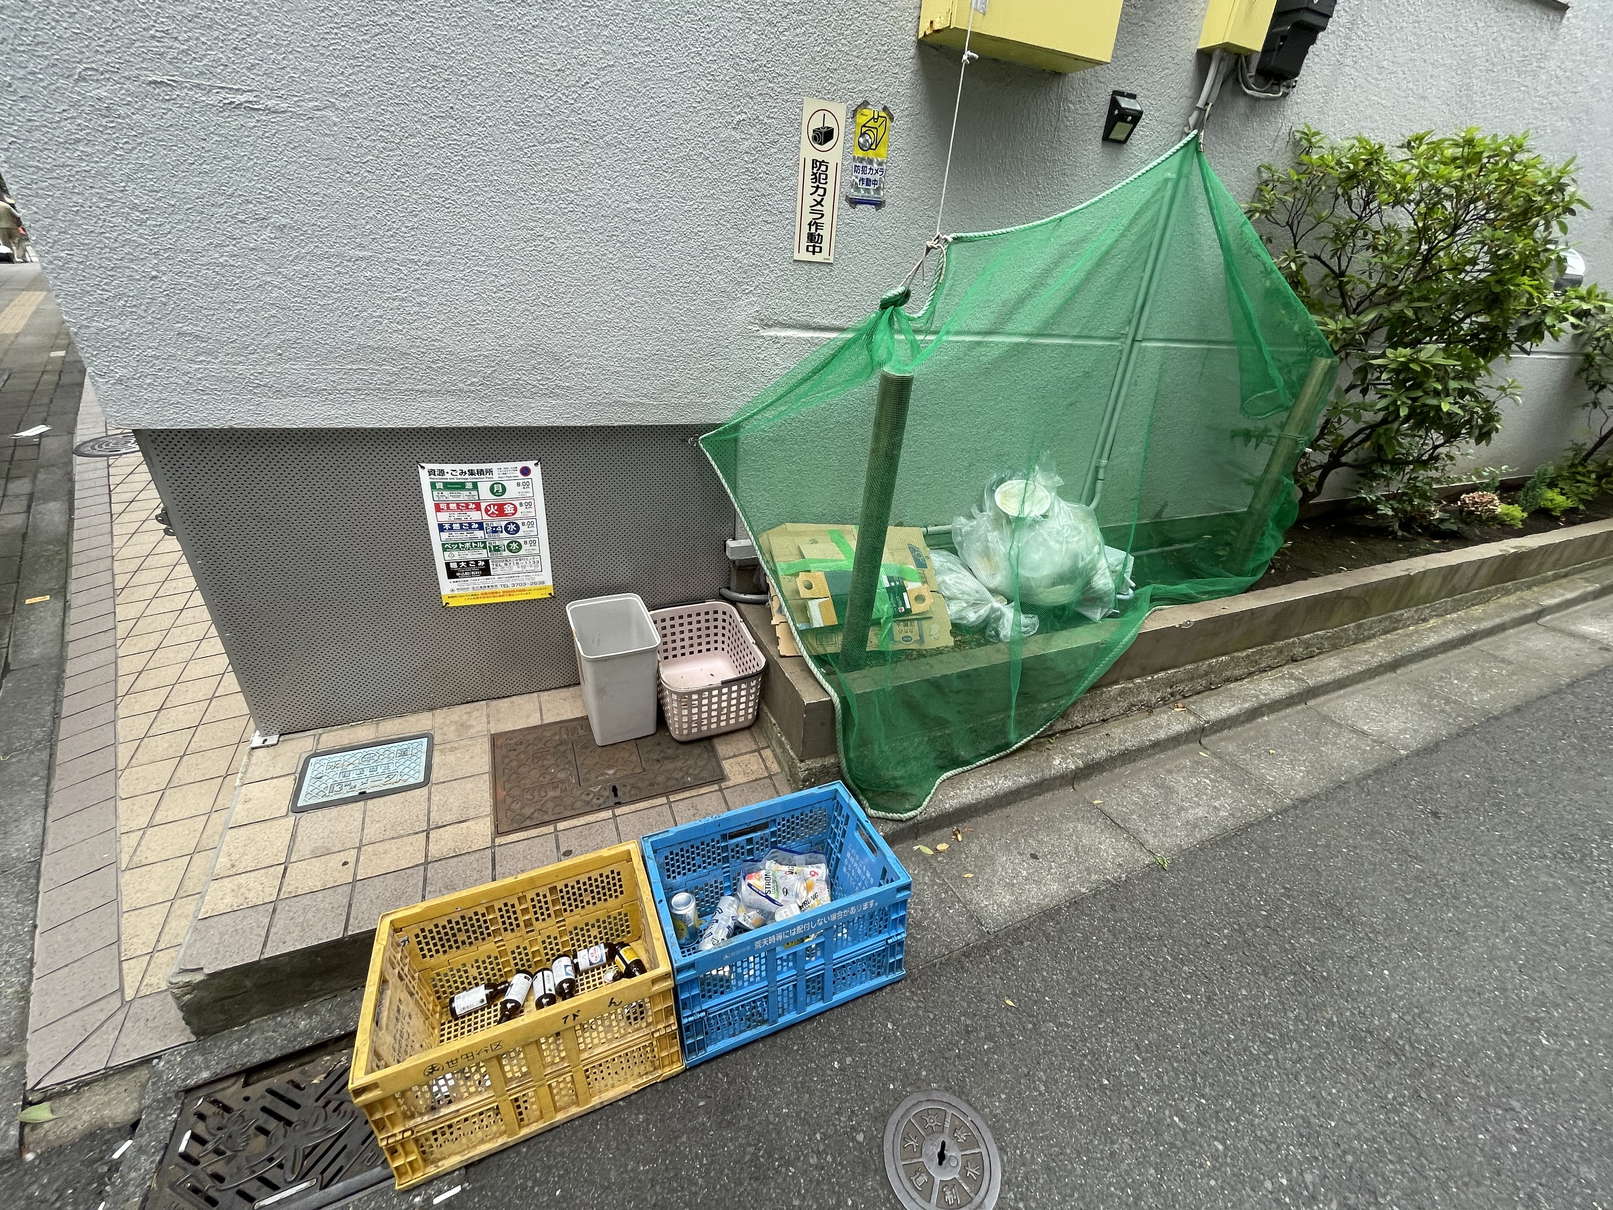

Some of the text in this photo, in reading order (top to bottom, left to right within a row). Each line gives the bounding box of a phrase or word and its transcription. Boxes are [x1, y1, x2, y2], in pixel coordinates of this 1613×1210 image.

[853, 165, 885, 176] 防犯カメラ
[859, 177, 879, 187] 作動中
[806, 159, 829, 255] 防犯カメラ作動中
[487, 503, 515, 514] 火 金
[507, 522, 517, 531] 水
[444, 541, 485, 549] ペットボトル
[509, 541, 519, 549] 水
